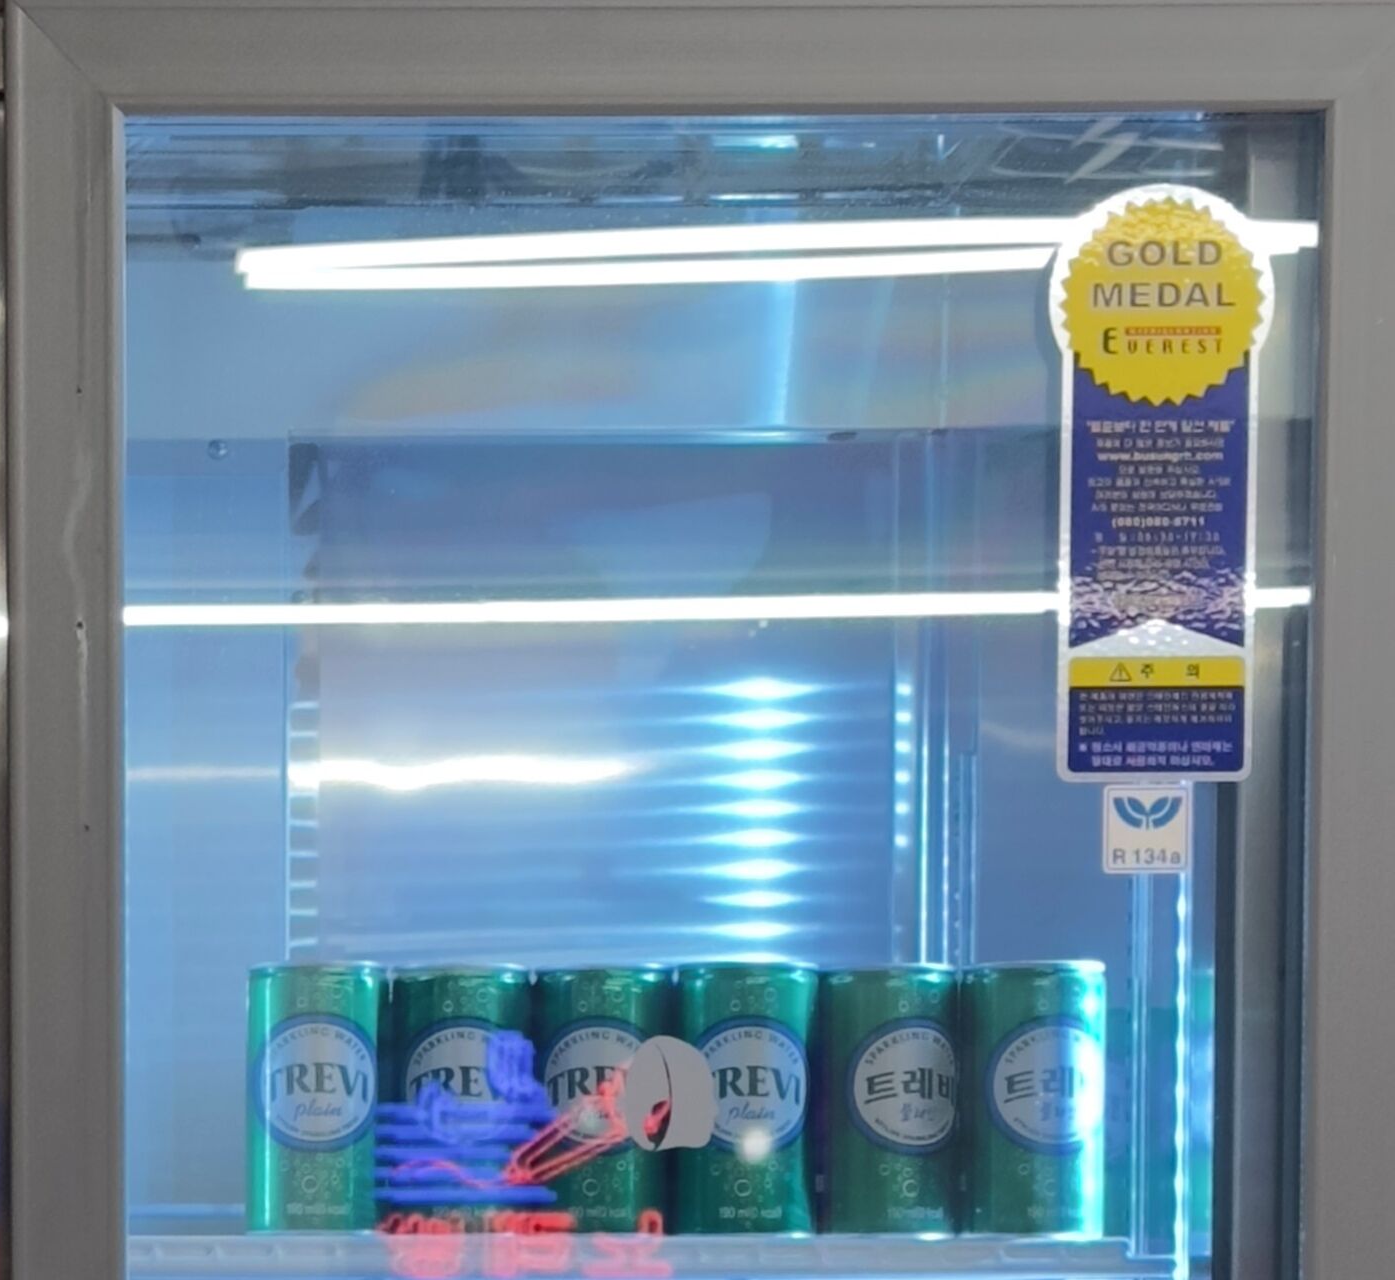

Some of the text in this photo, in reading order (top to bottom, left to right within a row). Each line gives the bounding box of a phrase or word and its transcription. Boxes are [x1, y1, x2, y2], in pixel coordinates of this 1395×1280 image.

[1107, 239, 1223, 267] GOLD
[1092, 281, 1236, 308] MEDAL
[1112, 850, 1182, 864] R 134a
[713, 1065, 801, 1106] REVI
[1005, 1067, 1080, 1104] 트레
[293, 1098, 343, 1121] plain
[726, 1100, 776, 1126] plain
